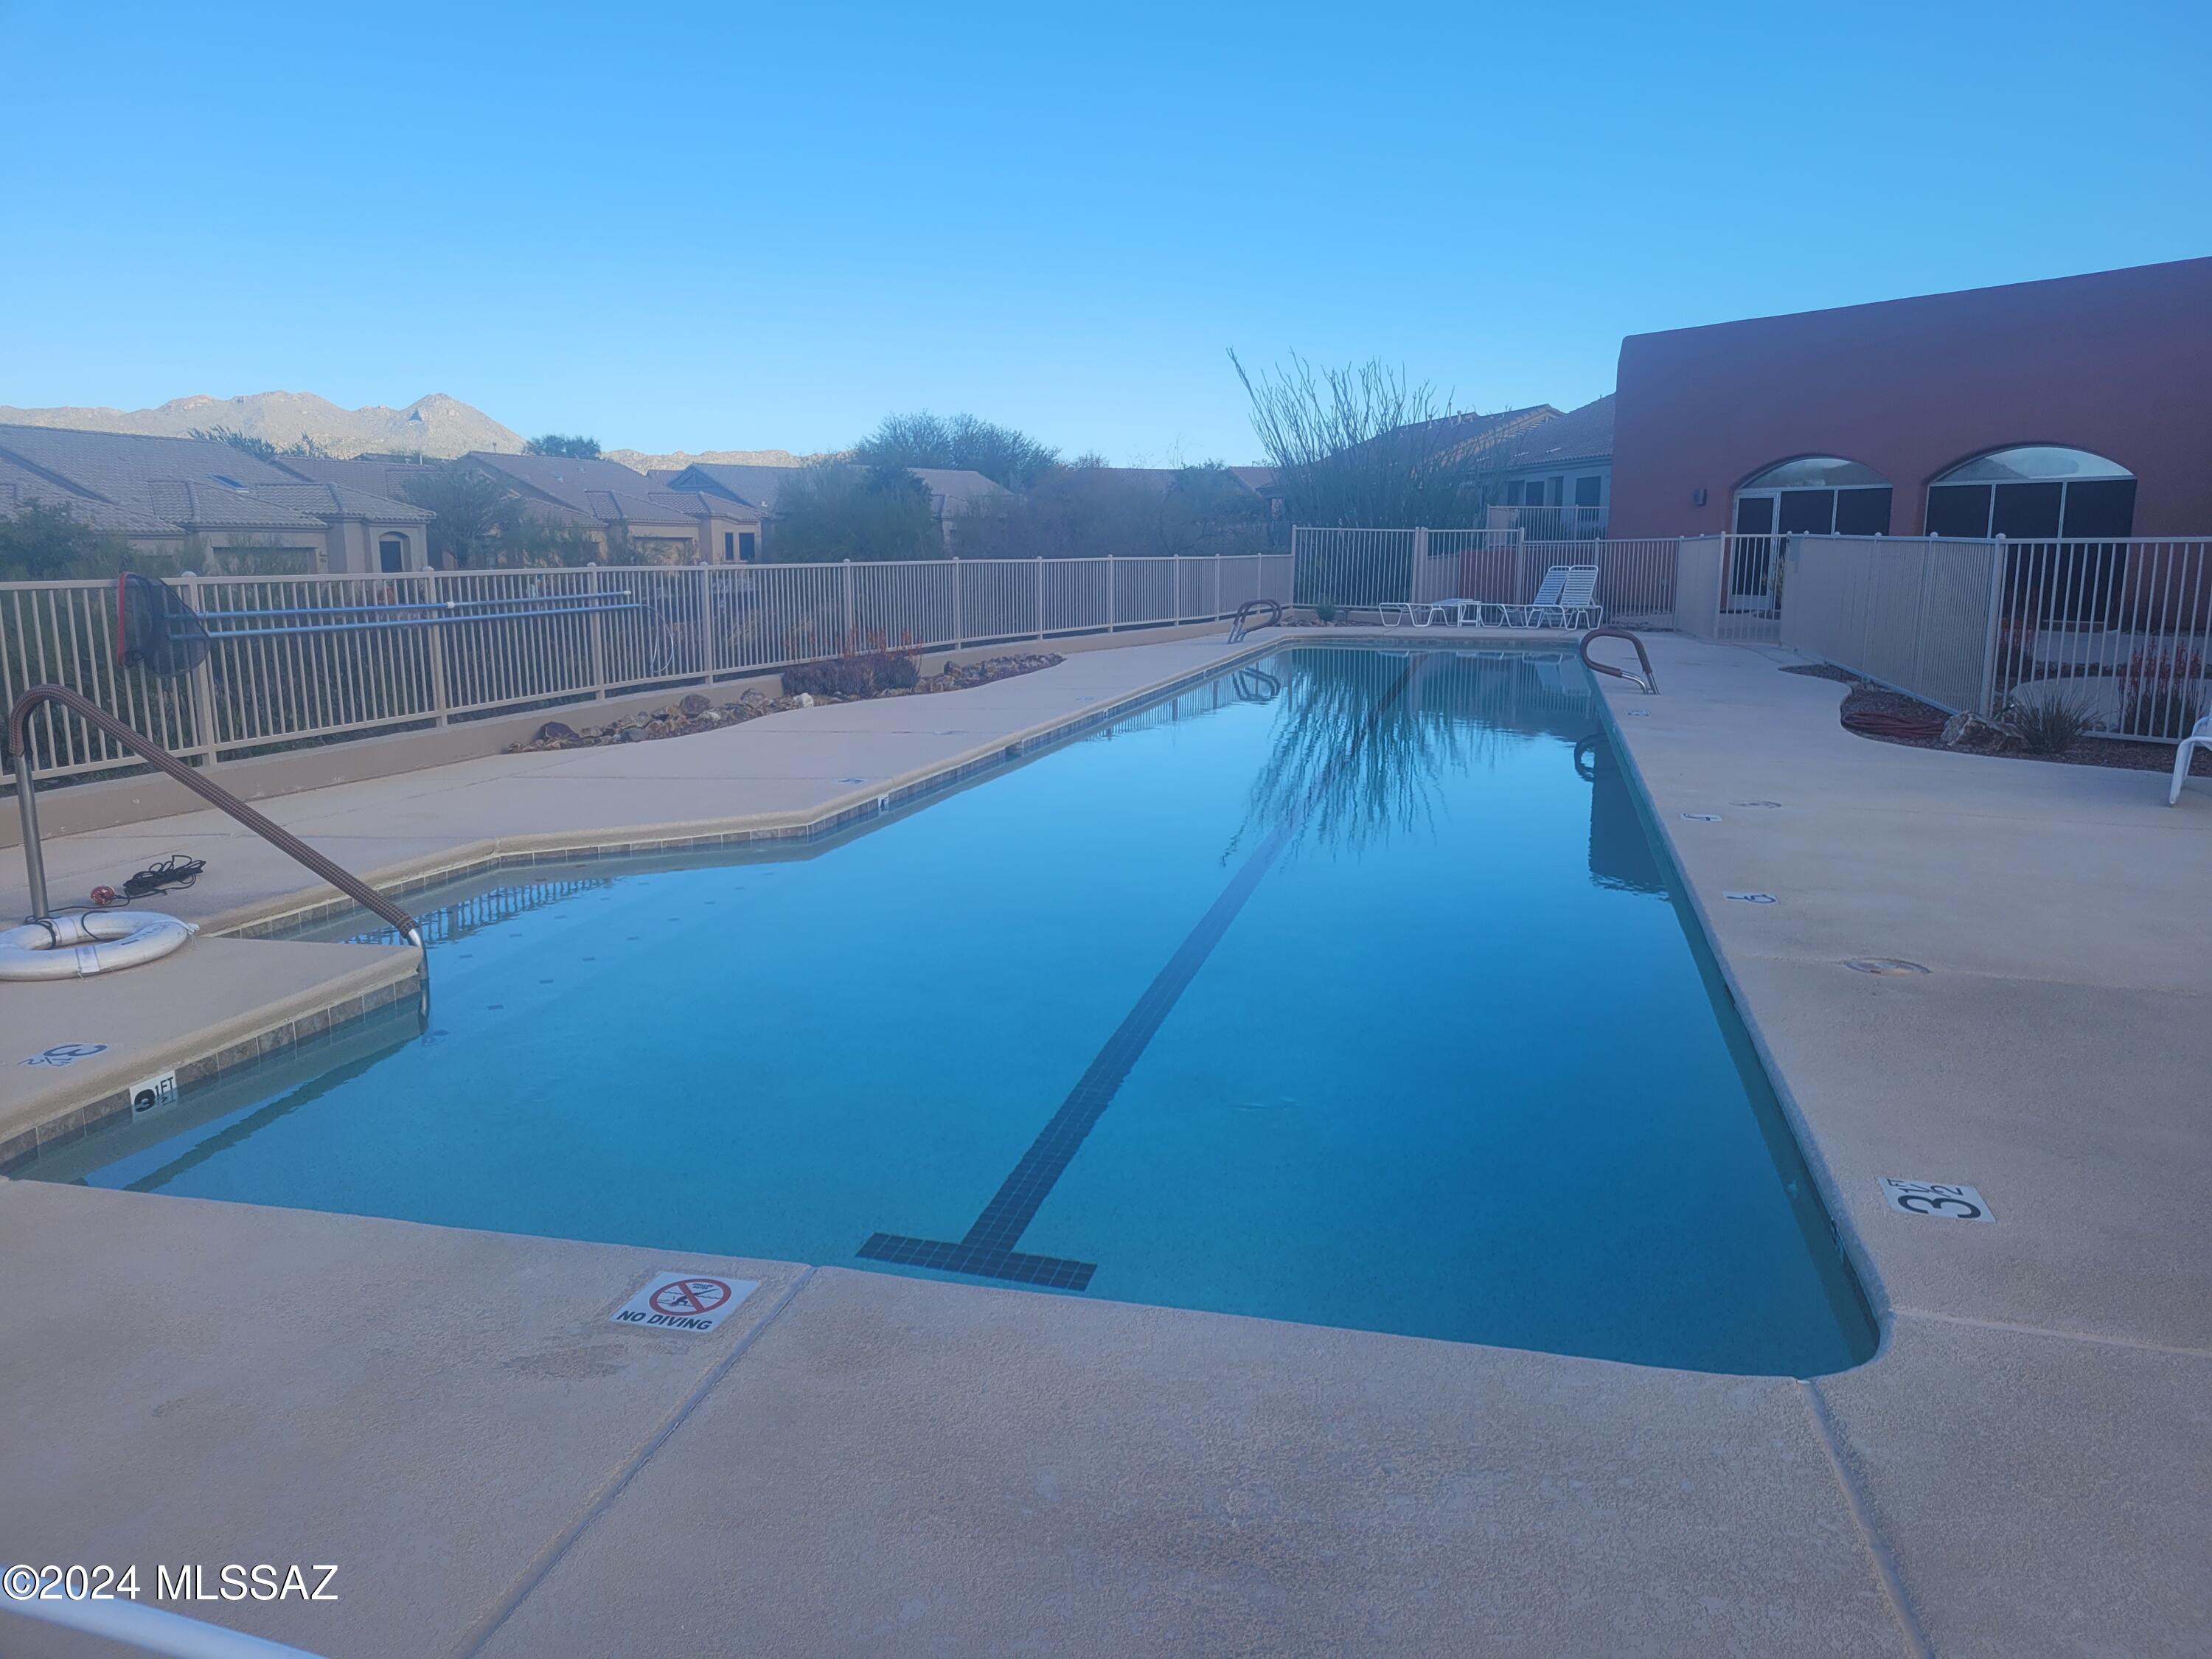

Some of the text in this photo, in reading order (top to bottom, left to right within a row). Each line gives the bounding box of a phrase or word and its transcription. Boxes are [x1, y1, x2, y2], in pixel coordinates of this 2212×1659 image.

[160, 1077, 174, 1093] FT
[1897, 1195, 1982, 1219] 3
[616, 1311, 712, 1330] NO DIVING
